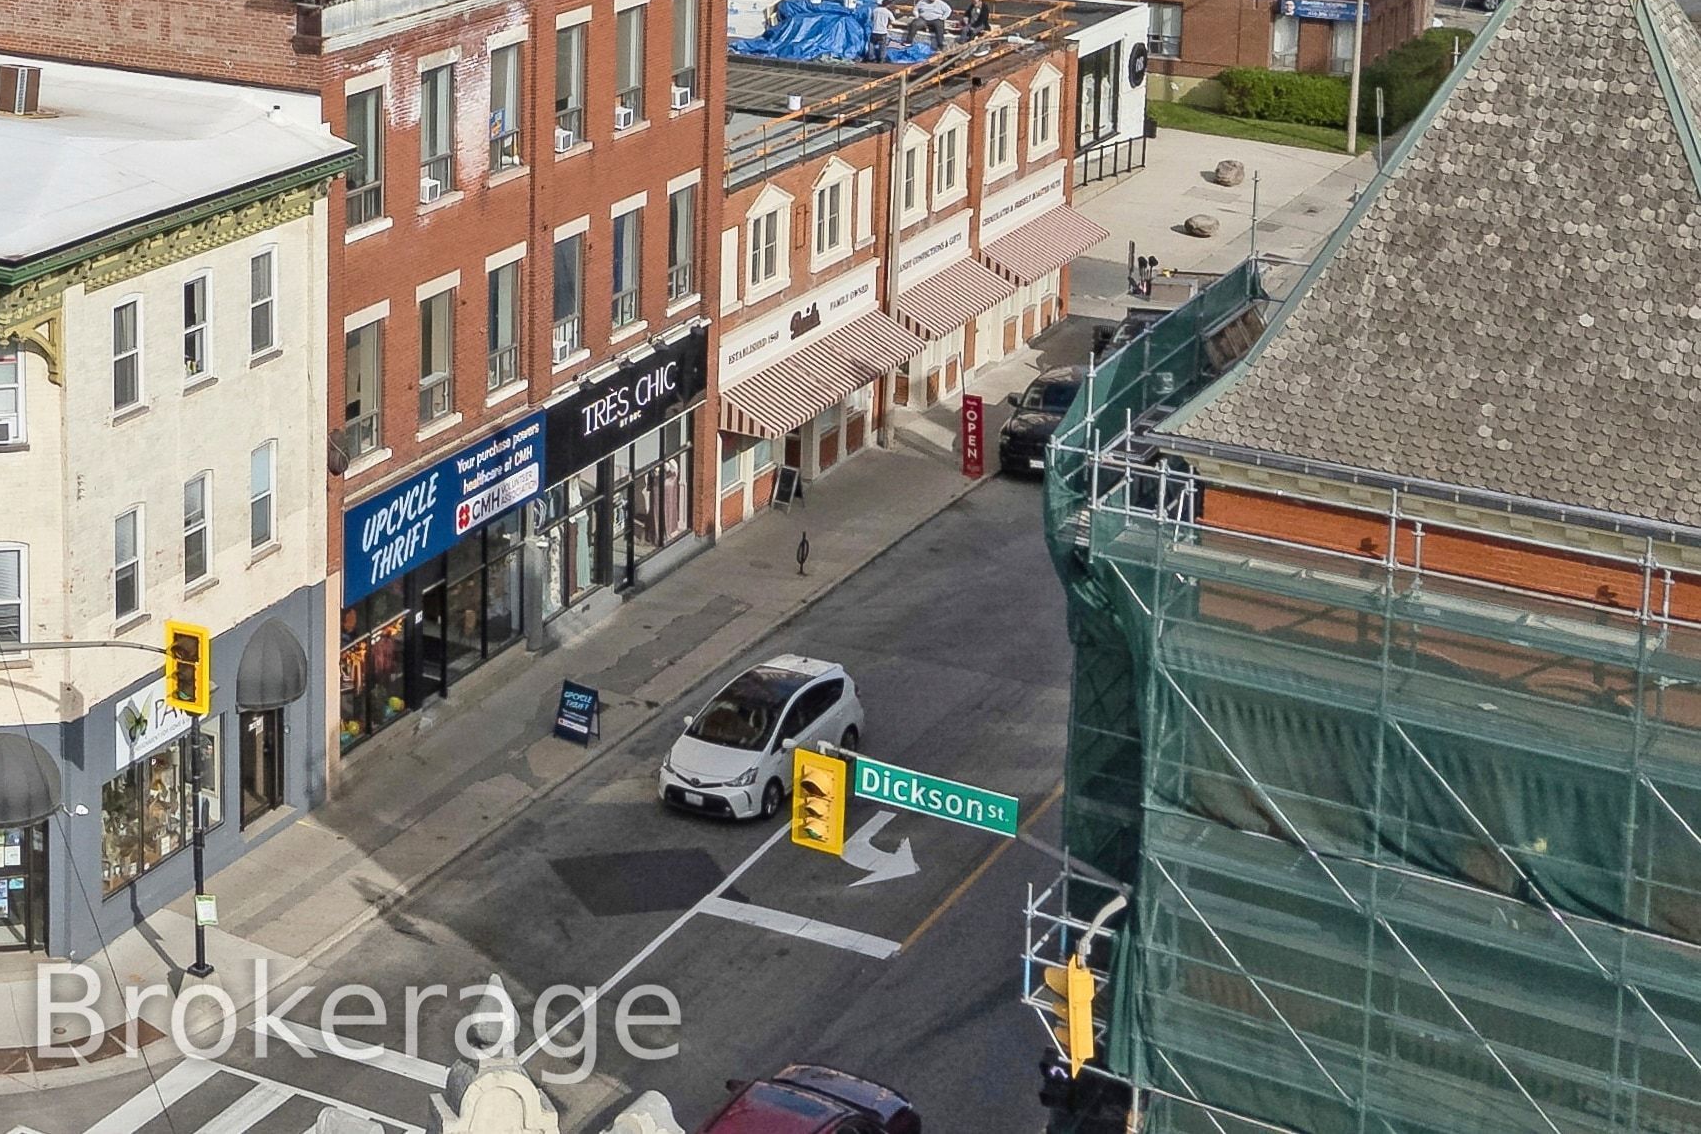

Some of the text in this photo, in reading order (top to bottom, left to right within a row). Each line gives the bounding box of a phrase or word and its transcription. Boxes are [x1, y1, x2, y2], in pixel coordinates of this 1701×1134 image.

[582, 361, 676, 436] TRÈS CHIC
[456, 423, 540, 474] Your purchase powers
[966, 410, 978, 459] OPEN
[463, 465, 503, 496] healthcare
[514, 445, 533, 467] CMH
[362, 472, 439, 553] UPCYCLE
[472, 487, 500, 520] CMH
[371, 513, 434, 585] THRIFT
[861, 767, 984, 822] Dickson
